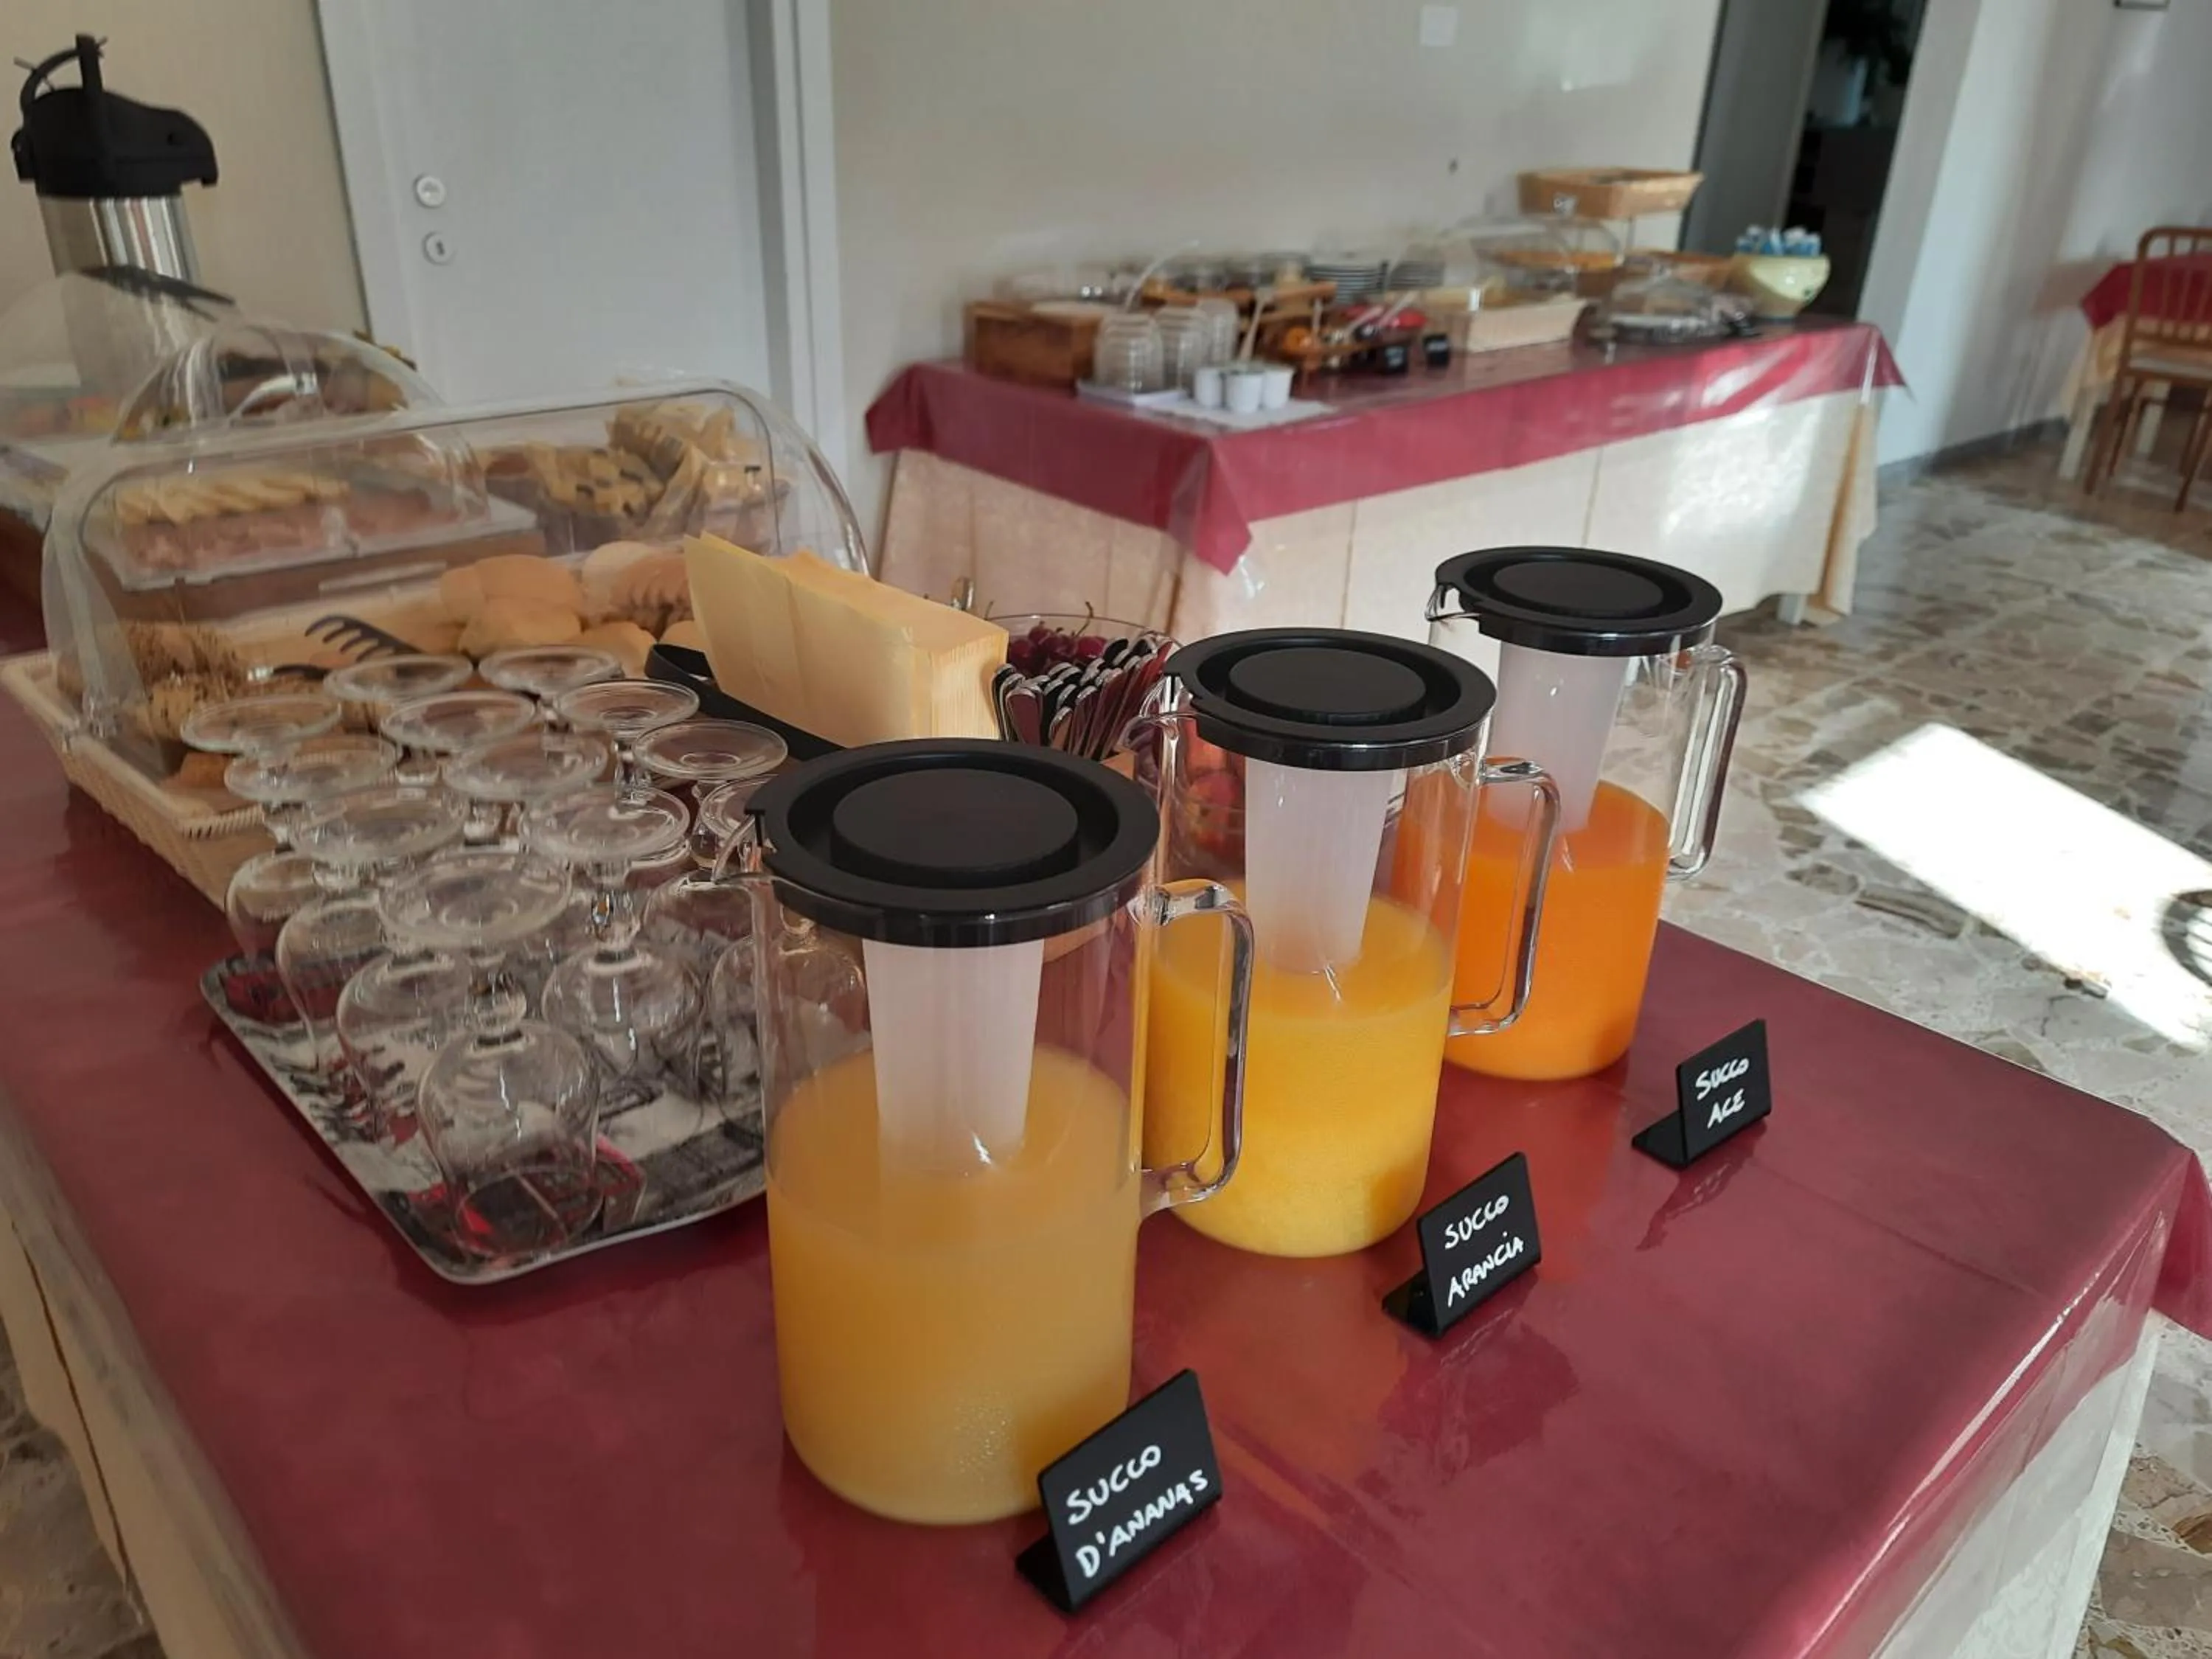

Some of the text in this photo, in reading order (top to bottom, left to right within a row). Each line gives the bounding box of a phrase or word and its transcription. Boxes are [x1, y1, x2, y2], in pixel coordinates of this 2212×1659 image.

[1695, 1057, 1750, 1101] SUCCO
[1707, 1088, 1745, 1129] ACE
[1444, 1194, 1509, 1250] SUCCO
[1066, 1444, 1161, 1526] SUCCO
[1075, 1469, 1208, 1578] D'ANANAS
